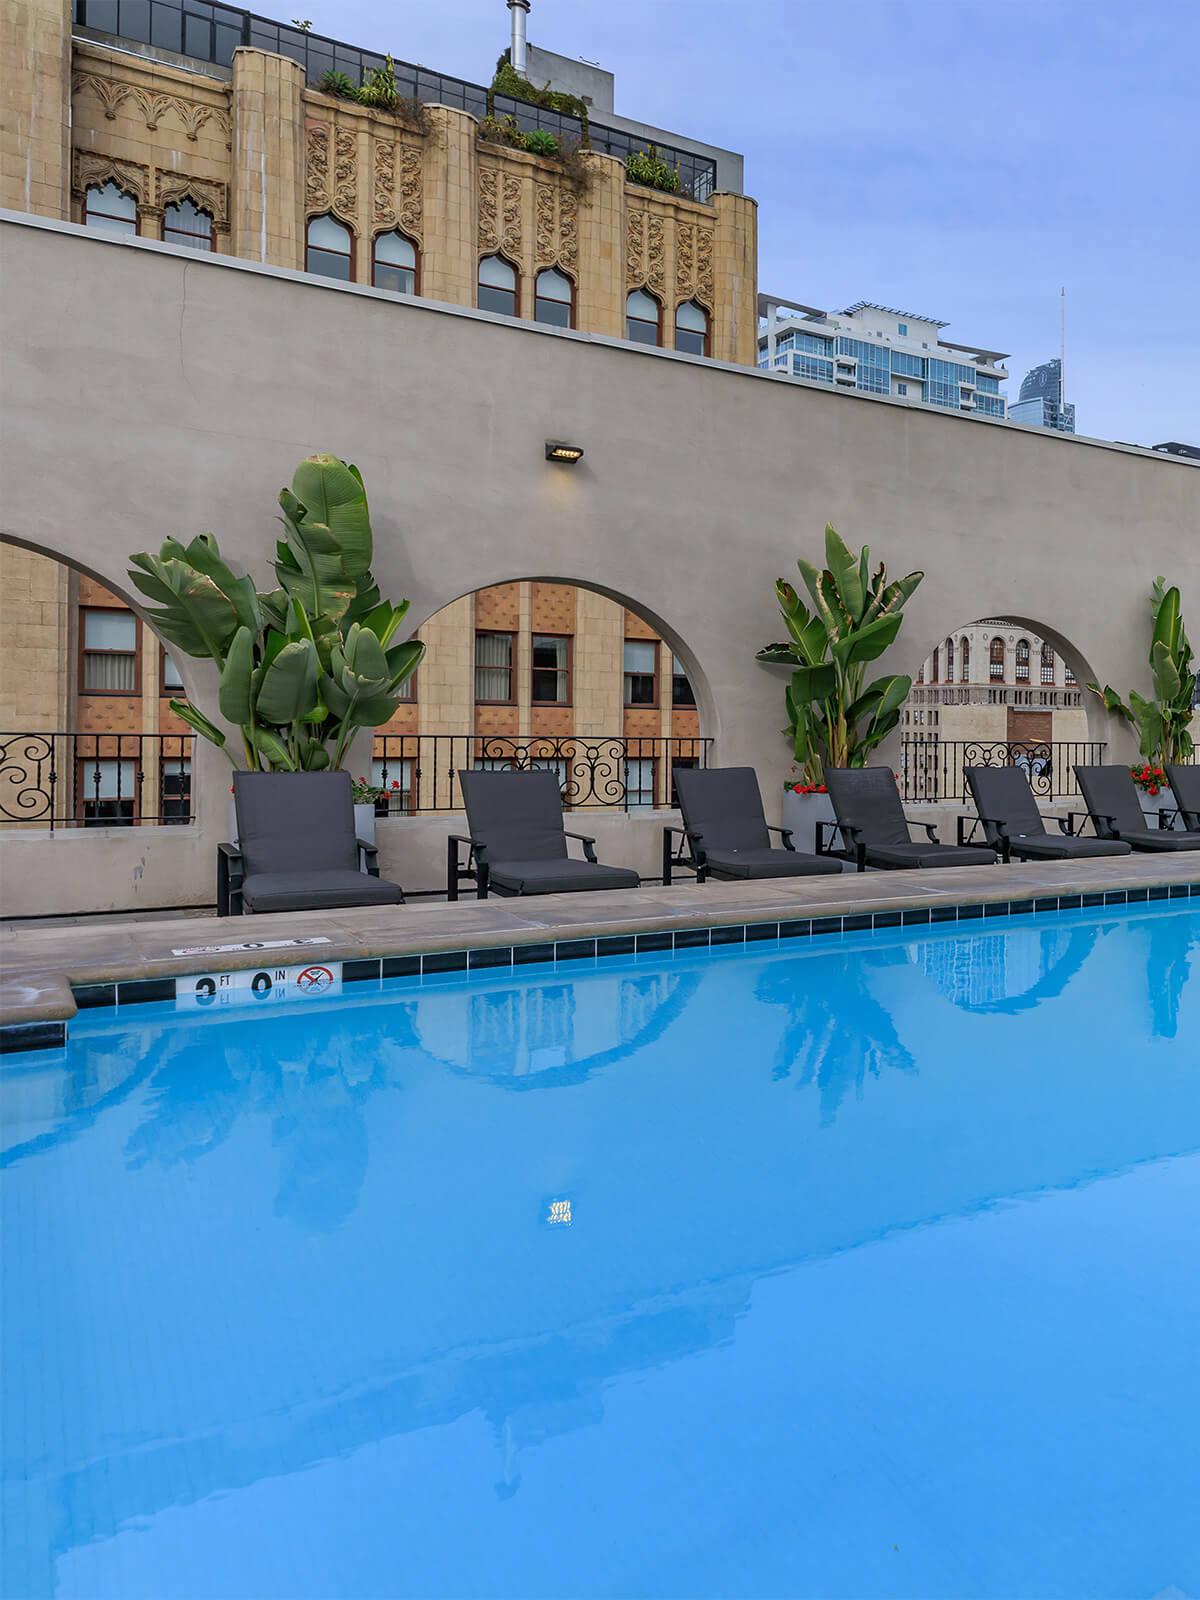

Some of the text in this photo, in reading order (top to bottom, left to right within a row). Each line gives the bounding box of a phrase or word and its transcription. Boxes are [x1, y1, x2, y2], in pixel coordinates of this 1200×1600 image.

[220, 974, 231, 986] FT
[251, 971, 273, 998] 0
[275, 970, 286, 981] IN
